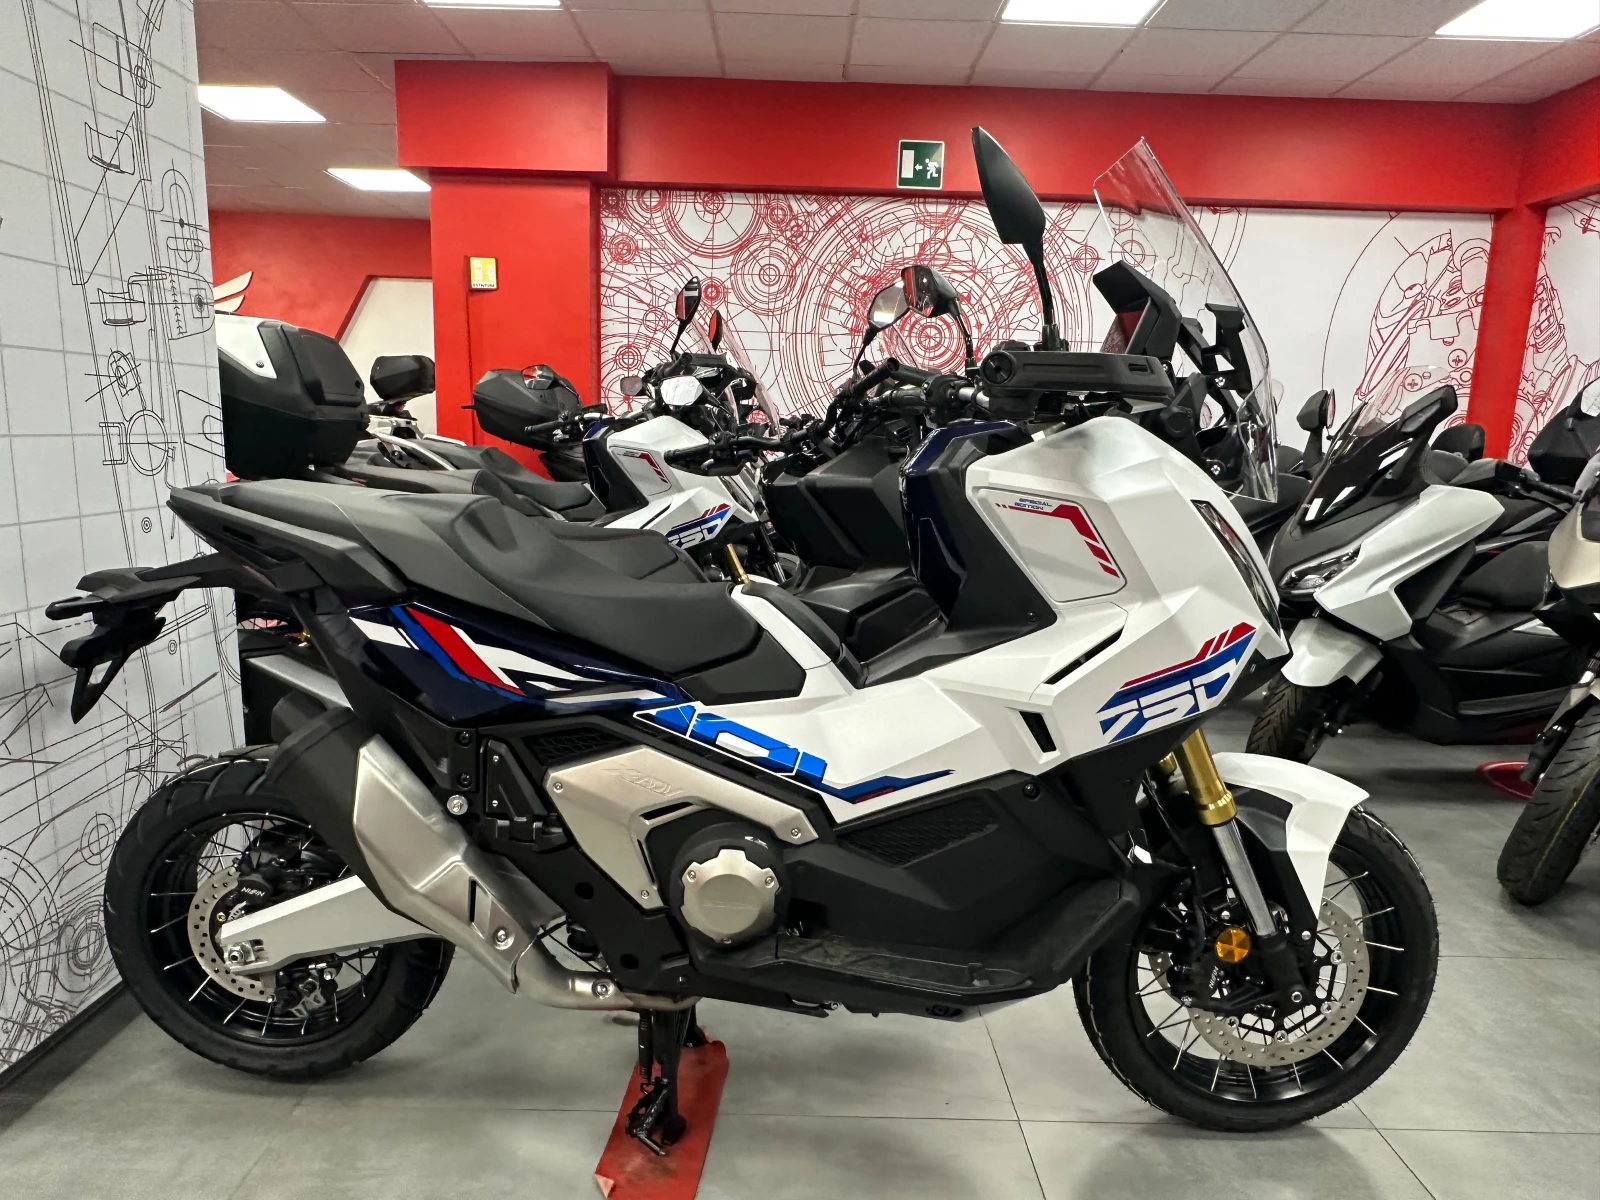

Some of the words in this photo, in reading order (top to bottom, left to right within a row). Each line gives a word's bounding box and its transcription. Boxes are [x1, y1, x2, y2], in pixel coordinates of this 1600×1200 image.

[1014, 502, 1044, 511] EDITION
[1018, 497, 1053, 508] SPECIAL
[1095, 657, 1238, 744] 750
